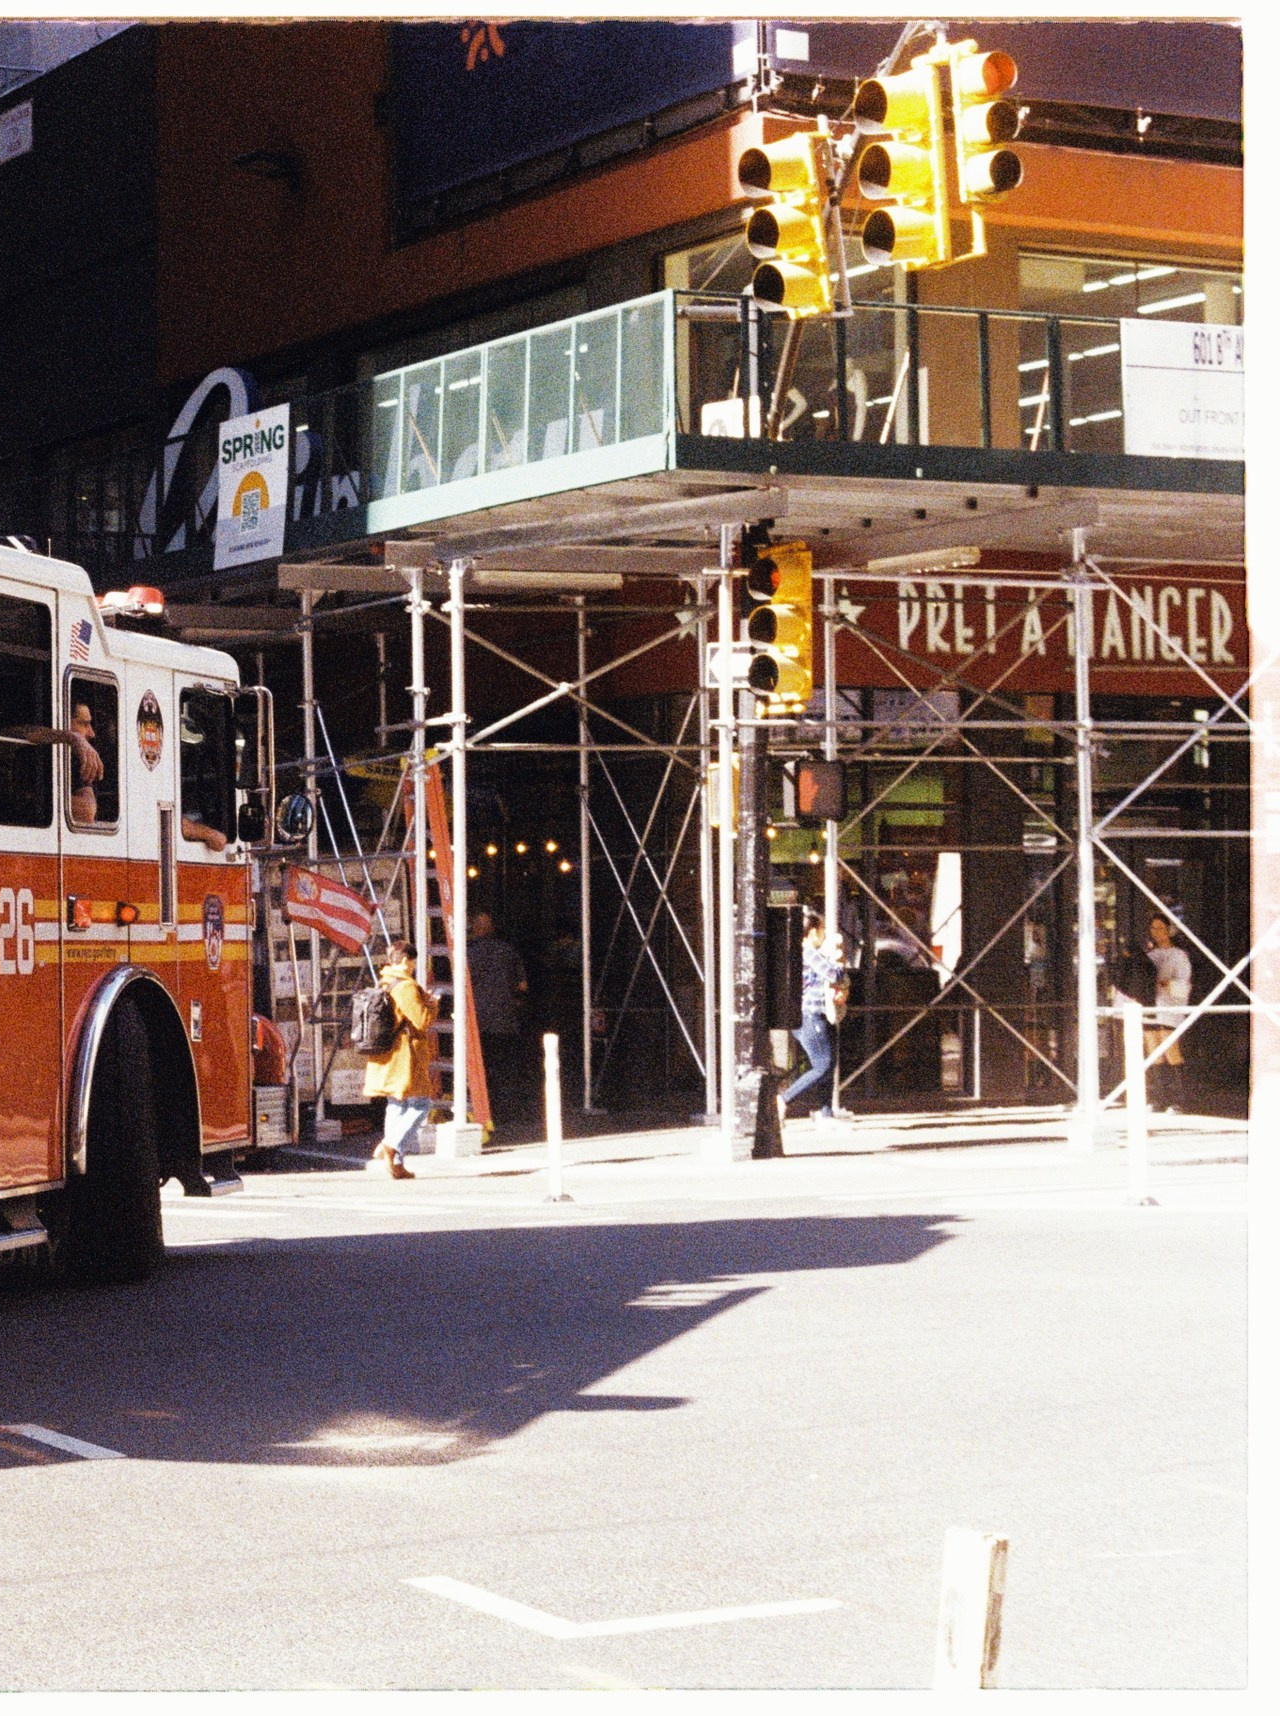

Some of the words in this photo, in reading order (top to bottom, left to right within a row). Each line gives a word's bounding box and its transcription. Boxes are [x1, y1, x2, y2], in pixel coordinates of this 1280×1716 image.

[1178, 408, 1201, 425] OUT
[1204, 409, 1239, 426] FRONT
[1020, 587, 1047, 657] A
